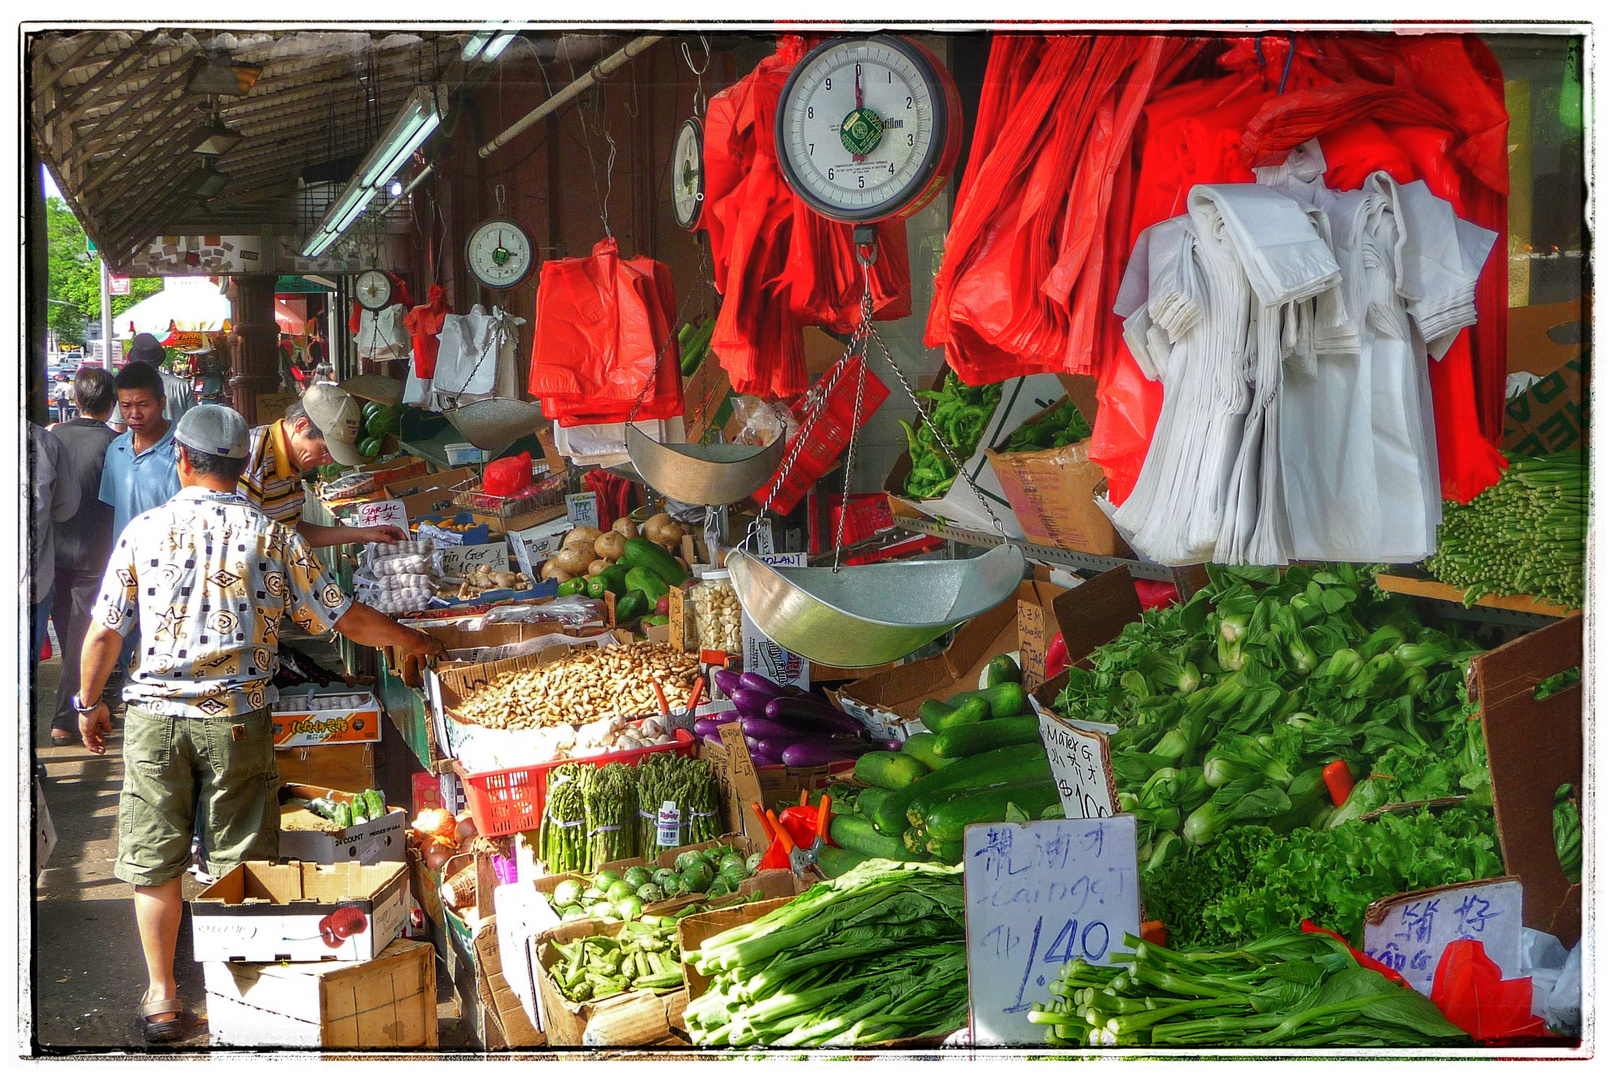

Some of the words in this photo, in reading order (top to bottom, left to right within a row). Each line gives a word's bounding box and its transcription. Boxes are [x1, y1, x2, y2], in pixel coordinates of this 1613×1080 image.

[888, 72, 892, 83] 1
[825, 78, 832, 91] 9
[906, 97, 913, 109] 2
[807, 107, 814, 119] 8
[907, 134, 914, 146] 3
[809, 144, 815, 156] 7
[828, 168, 835, 181] 6
[888, 163, 895, 175] 4
[858, 176, 865, 188] 5
[774, 661, 788, 687] Farms
[343, 833, 364, 845] COUNT
